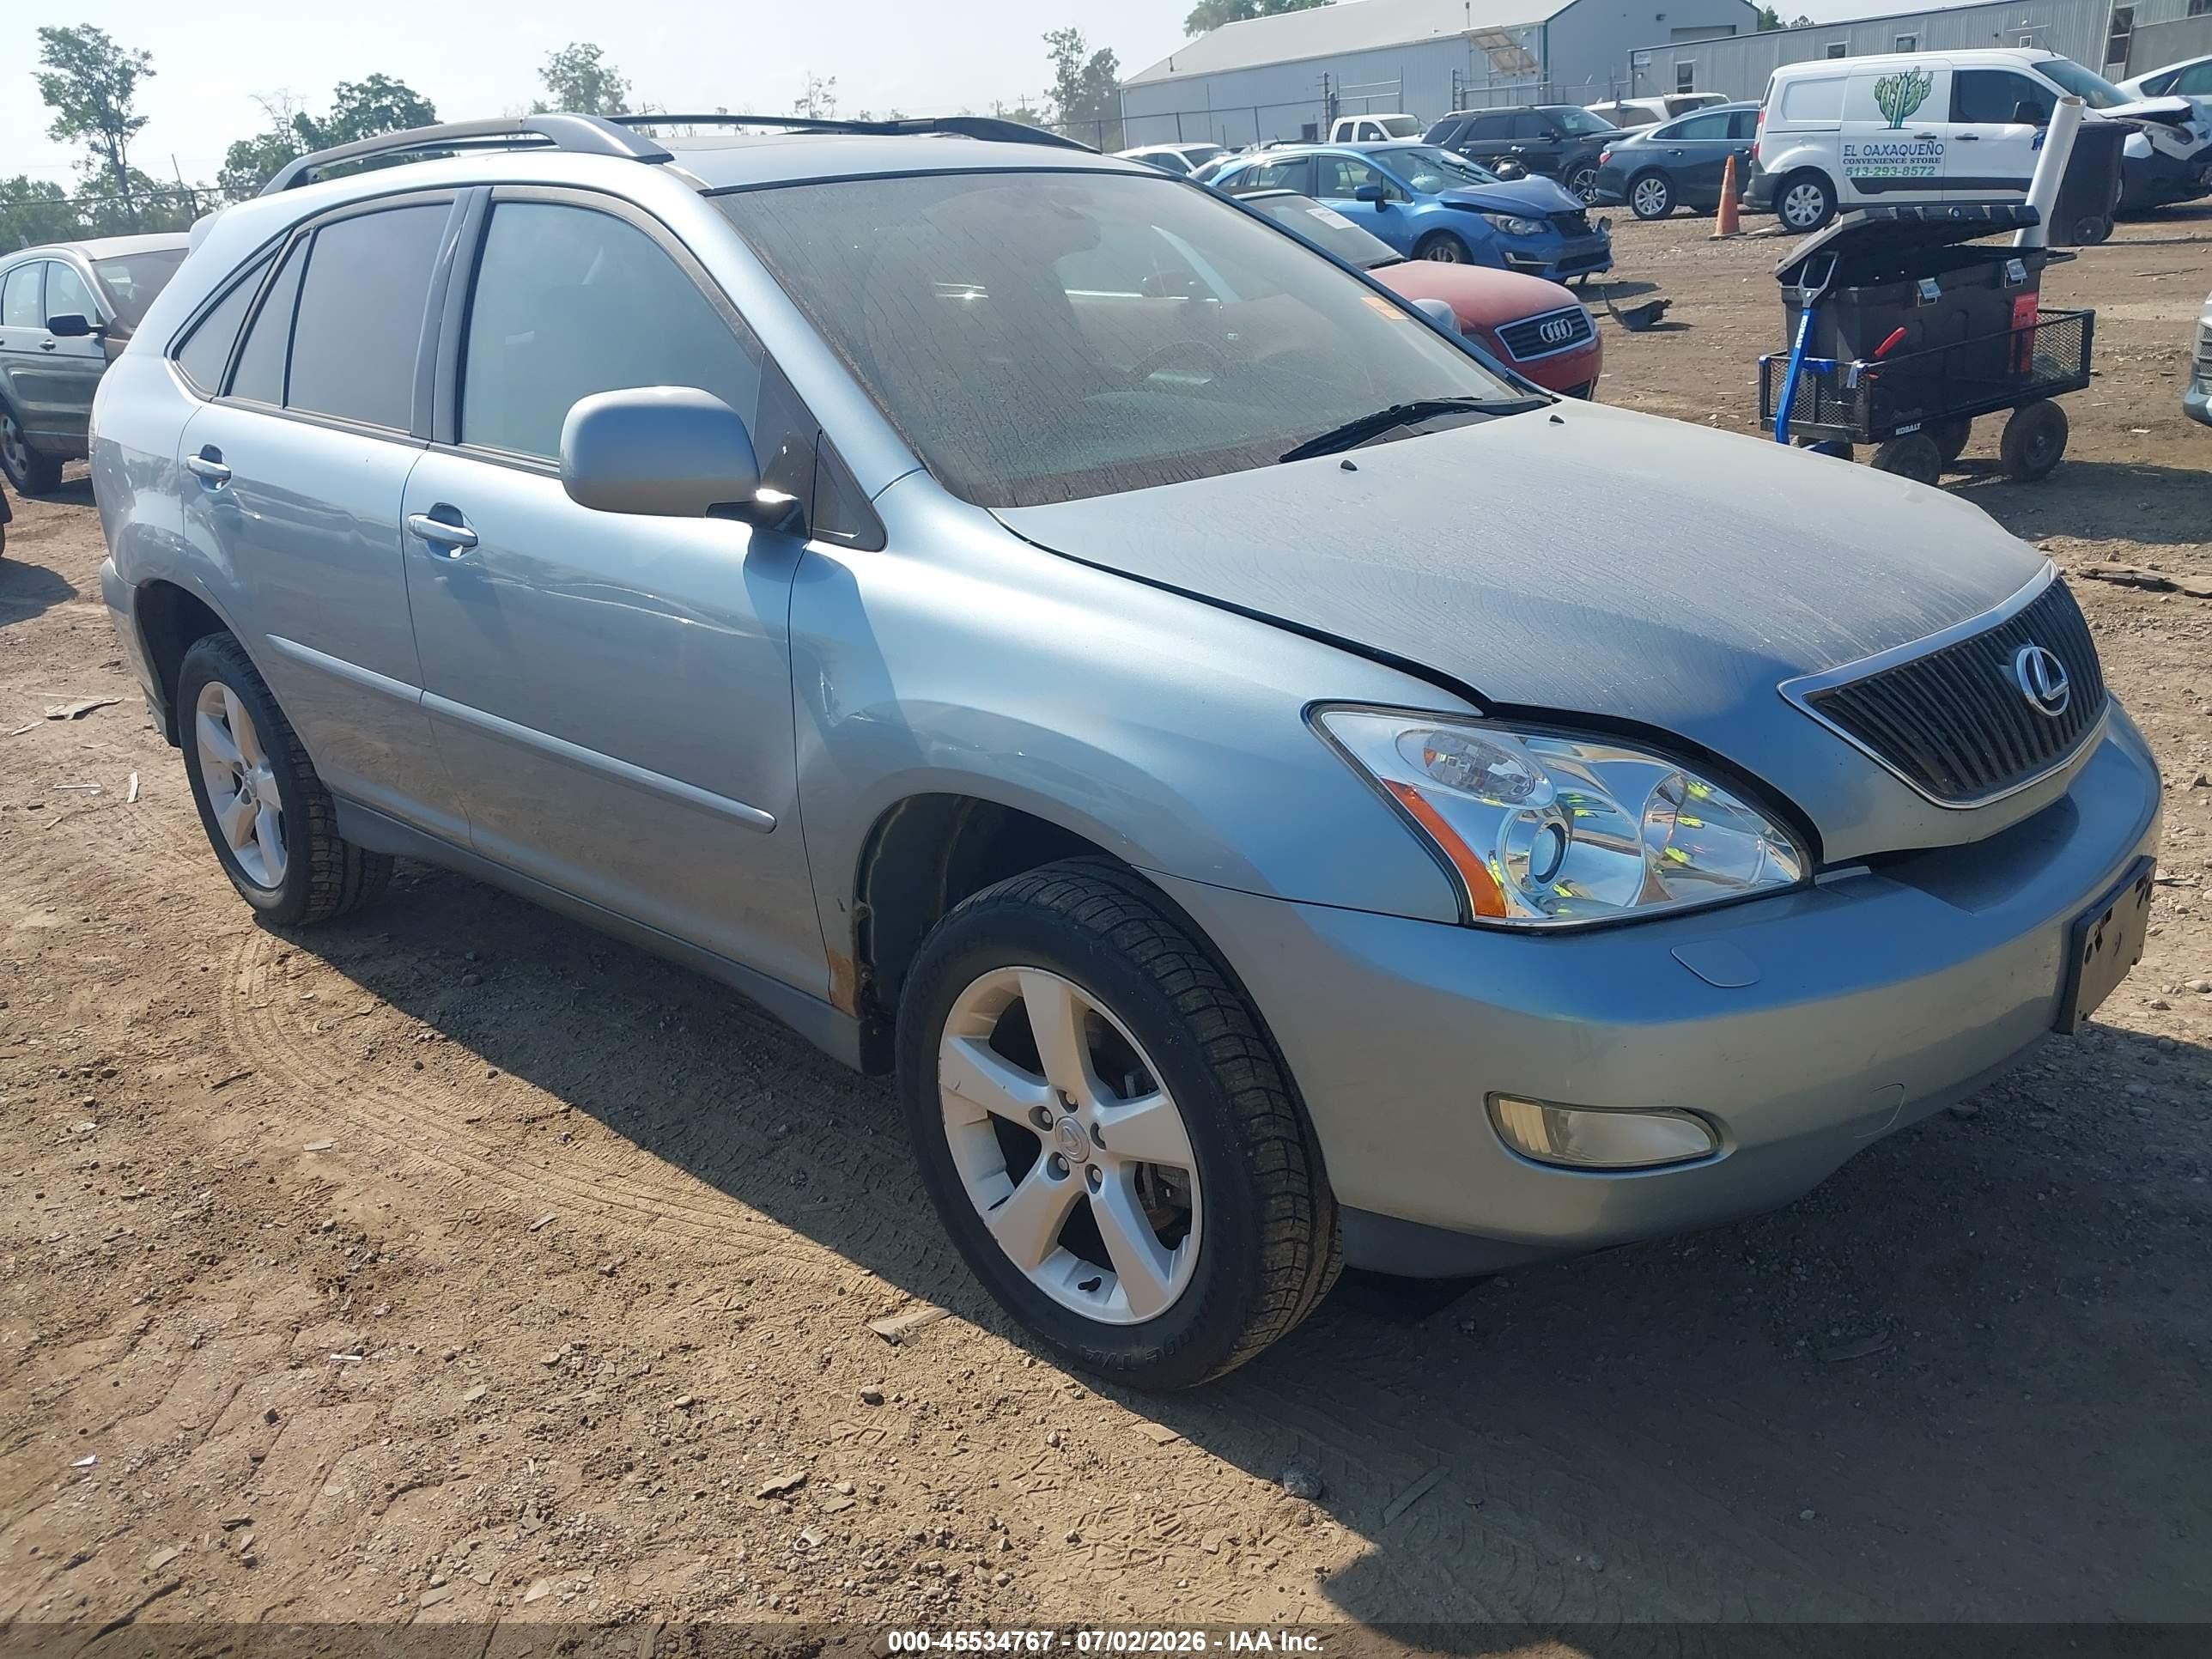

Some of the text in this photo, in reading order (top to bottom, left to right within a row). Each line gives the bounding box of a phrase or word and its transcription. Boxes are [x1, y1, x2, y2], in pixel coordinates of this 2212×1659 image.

[1843, 140, 1944, 157] EL OAXAQUEÑO
[1844, 166, 1936, 177] 513-293-8572
[1895, 422, 1922, 435] KOBALT
